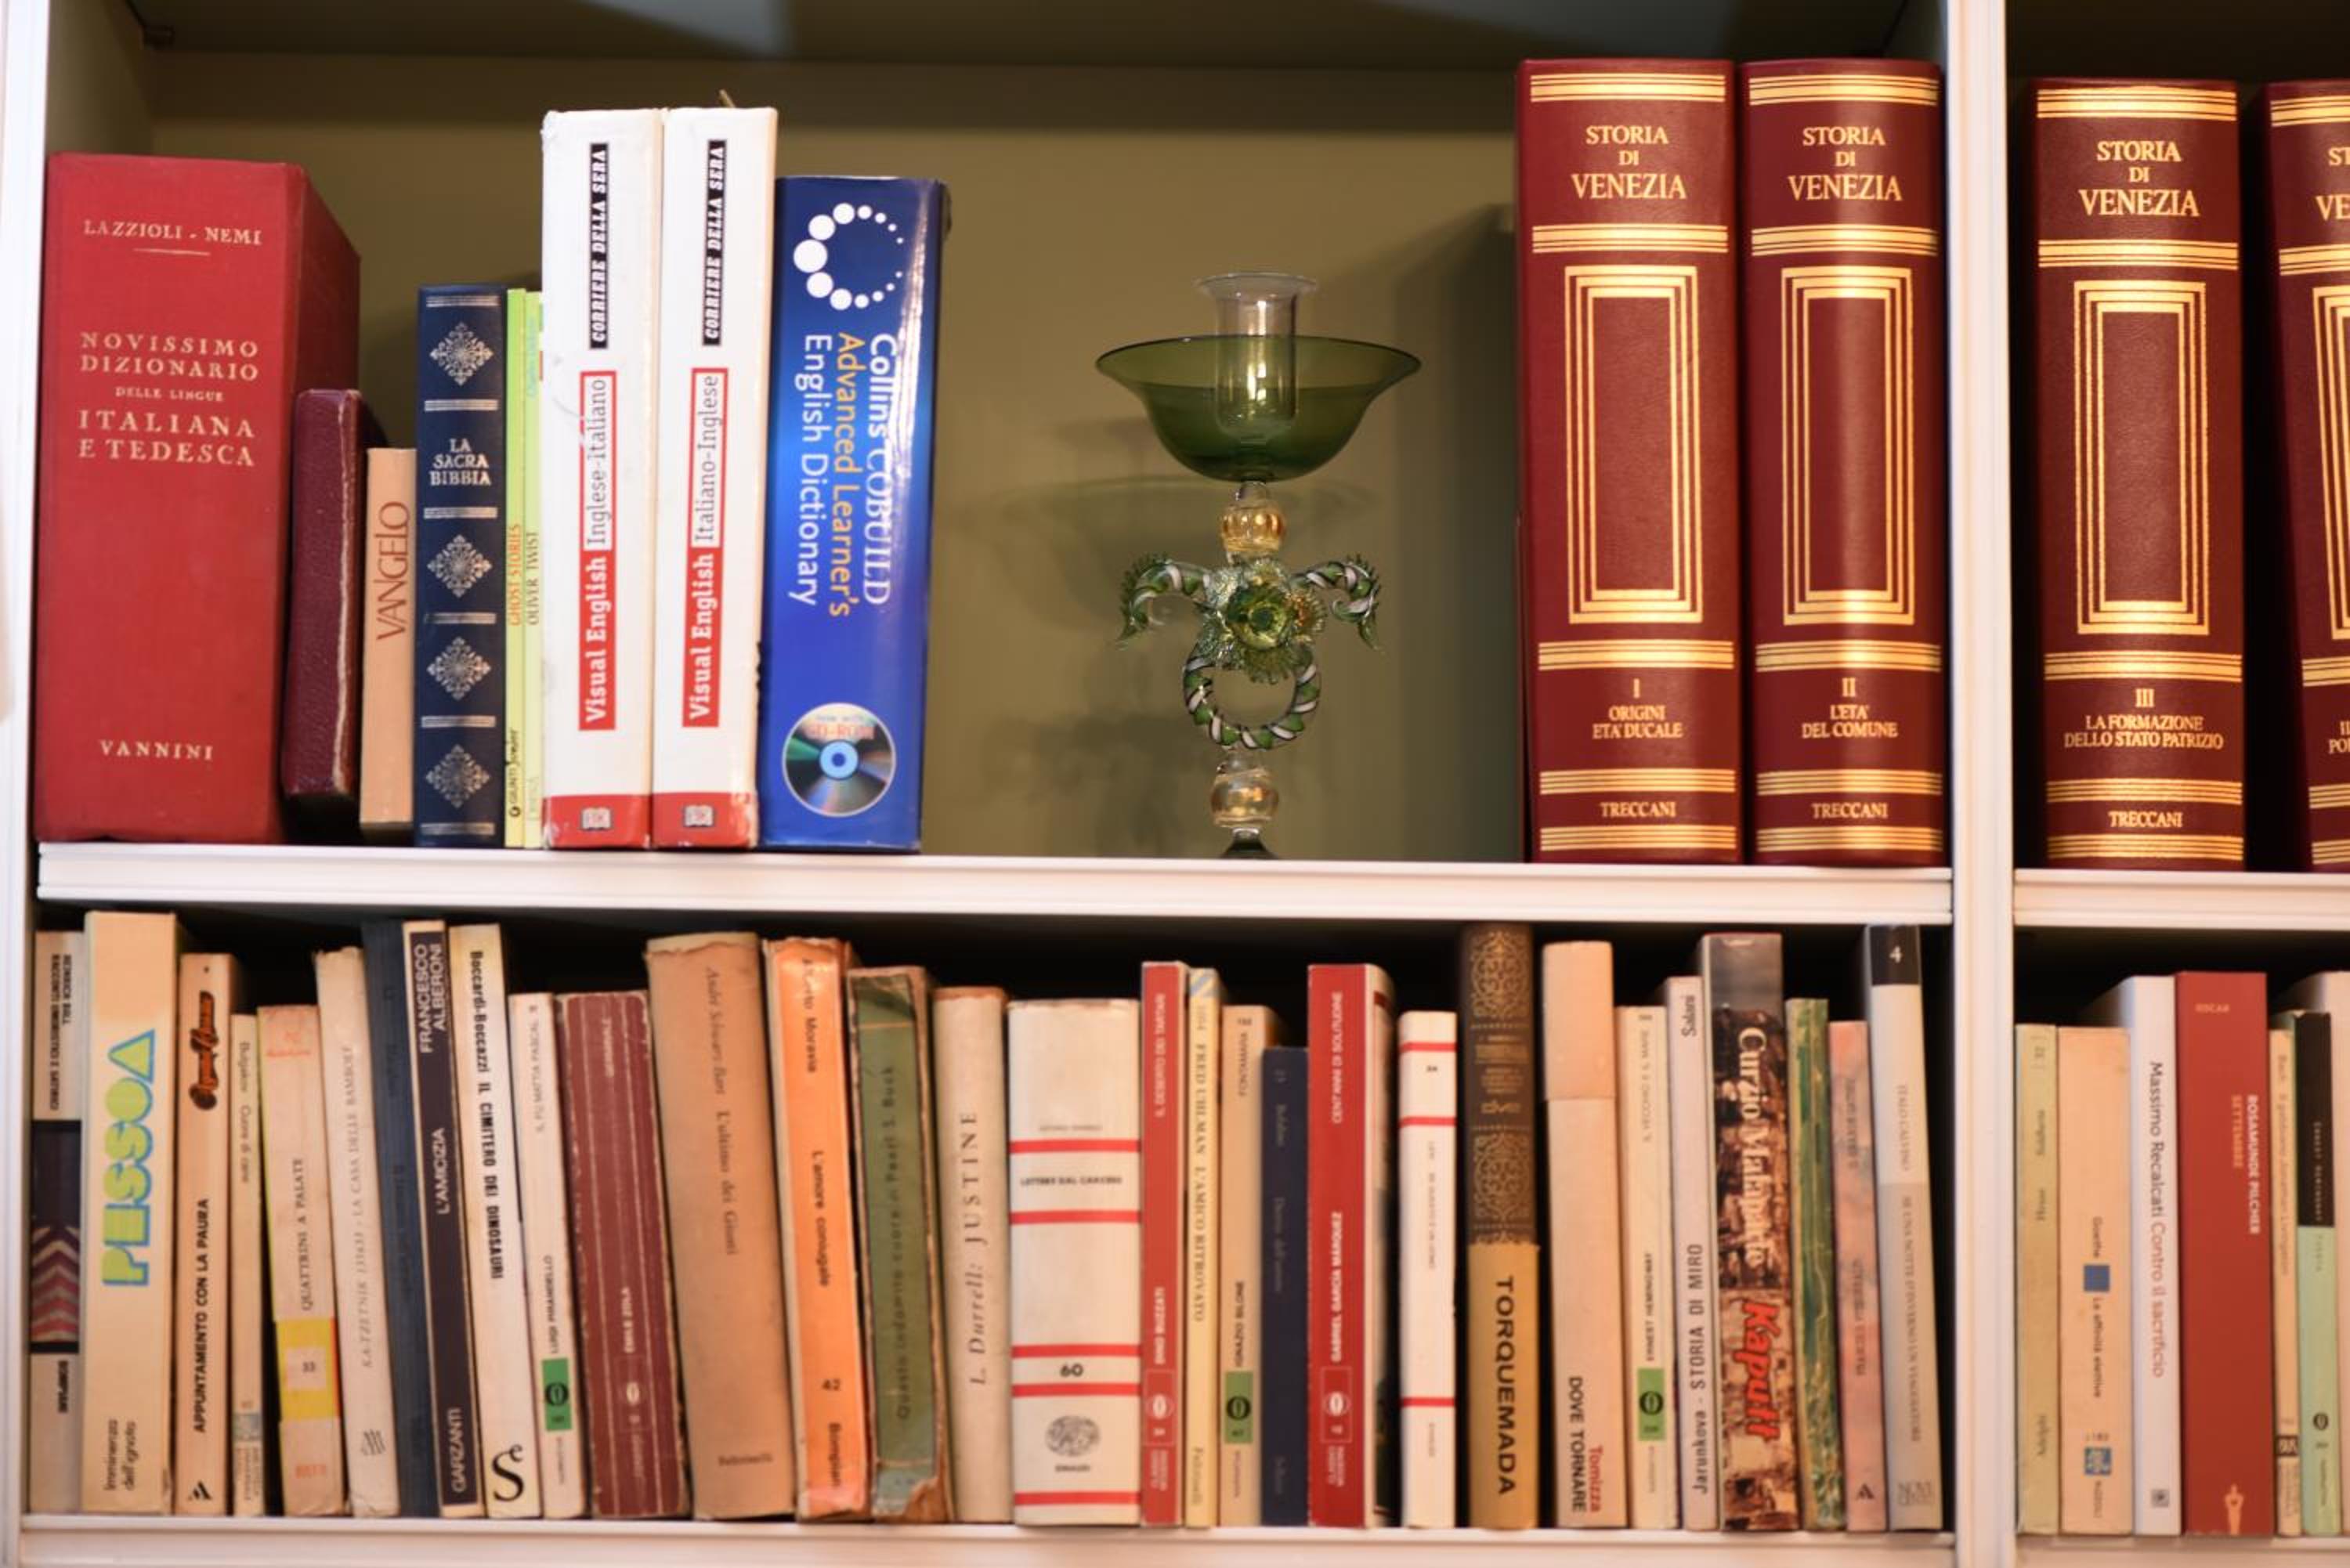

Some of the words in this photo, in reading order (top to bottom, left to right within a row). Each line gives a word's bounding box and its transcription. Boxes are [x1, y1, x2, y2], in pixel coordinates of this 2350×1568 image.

[1585, 125, 1669, 146] STORIA
[1618, 150, 1640, 166] DI
[1802, 126, 1886, 146] STORIA
[1835, 151, 1856, 168] DI
[2097, 140, 2182, 162] STORIA
[590, 150, 606, 193] SERA
[708, 147, 725, 190] SERA
[1571, 173, 1687, 201] VENEZIA
[1788, 175, 1903, 201] VENEZIA
[2129, 166, 2150, 182] DI
[707, 198, 724, 250] DELLA
[2079, 189, 2200, 217] VENEZIA
[84, 219, 183, 240] LAZZIOLI
[204, 226, 262, 245] NEMI
[590, 201, 606, 254] DELLA
[590, 261, 606, 343] CORRIERE
[704, 256, 723, 339] CORRIERE
[81, 332, 258, 359] NOVISSIMO
[81, 355, 258, 381] DIZIONARIO
[115, 386, 162, 399] DELLE
[170, 388, 223, 402] LINGUE
[794, 334, 832, 443] English
[834, 332, 866, 472] Advanced
[868, 334, 898, 439] Collins
[79, 410, 255, 438] ITALIANA
[449, 438, 472, 453] LA
[79, 439, 96, 459] E
[105, 439, 255, 467] TEDESCA
[432, 453, 490, 469] SACRA
[586, 379, 613, 545] Inglese-Italiano
[693, 375, 722, 541] Italiano-Inglese
[429, 470, 493, 486] BIBBIA
[508, 523, 522, 577] STORIES
[788, 453, 828, 605] Dictionary
[829, 484, 860, 616] Learner's
[864, 447, 893, 605] COBUILD
[374, 501, 409, 641] VANGELO
[524, 531, 539, 571] TWIST
[508, 582, 522, 627] GHOST
[525, 578, 540, 626] OLIVER
[588, 557, 613, 642] English
[692, 554, 718, 639] English
[586, 651, 609, 722] Visual
[689, 647, 713, 719] Visual
[1633, 678, 1640, 699] I
[1842, 677, 1857, 698] II
[2135, 688, 2154, 708] III
[1608, 705, 1666, 722] ORIGINI
[1624, 722, 1683, 739] DUCALE
[1802, 722, 1831, 739] DEL
[1832, 721, 1899, 739] COMUNE
[2086, 715, 2106, 731] LA
[2107, 714, 2204, 732] FORMAZIONE
[99, 739, 214, 761] VANNINI
[2064, 732, 2113, 748] DELLO
[2115, 732, 2160, 747] STATO
[2162, 732, 2225, 750] PATRIZIO
[1600, 800, 1677, 818] TRECCANI
[1812, 802, 1889, 820] TRECCANI
[2109, 811, 2184, 828] TRECCANI
[1889, 945, 1902, 963] 4
[414, 944, 433, 1053] FRANCESCO
[430, 944, 446, 1031] ALBERONI
[470, 950, 490, 1073] Boccardi-Boccazzi
[1680, 995, 1697, 1037] Salani
[804, 1017, 819, 1073] Moravia
[1195, 1042, 1207, 1086] FRED
[478, 1082, 491, 1094] IL
[1737, 1026, 1768, 1120] Curzio
[1195, 1088, 1207, 1154] UHLMAN
[2149, 1061, 2164, 1136] Massimo
[479, 1102, 497, 1167] CIMITERO
[2247, 1094, 2259, 1179] ROSAMUNDE
[292, 1158, 306, 1209] PALATE
[349, 1158, 362, 1194] CASA
[432, 1128, 451, 1214] L'AMICIZIA
[483, 1174, 497, 1197] DEI
[959, 1112, 988, 1246] JUSTINE
[2150, 1141, 2165, 1217] Recalcati
[1194, 1166, 1206, 1231] L'AMICO
[1735, 1122, 1773, 1269] Malaparte
[2248, 1180, 2261, 1234] PILCHER
[195, 1198, 210, 1248] PAURA
[296, 1215, 307, 1225] A
[485, 1205, 504, 1280] DINOSAURI
[195, 1254, 209, 1272] LA
[297, 1231, 314, 1312] QUATTRINI
[1686, 1244, 1703, 1290] MIRO
[2151, 1221, 2167, 1279] Contro
[194, 1277, 208, 1306] CON
[1193, 1234, 1206, 1322] RITROVATO
[2153, 1287, 2167, 1295] il
[1687, 1299, 1705, 1316] DI
[1331, 1313, 1343, 1363] GABRIEL
[1688, 1327, 1705, 1389] STORIA
[2152, 1301, 2167, 1378] sacrificio
[193, 1311, 208, 1433] APPUNTAMENTO
[822, 1378, 841, 1391] 42
[1059, 1363, 1085, 1378] 60
[1495, 1275, 1517, 1495] TORQUEMADA
[1732, 1302, 1781, 1441] Kaputt
[1568, 1376, 1585, 1424] DOVE
[446, 1407, 468, 1493] GARZANTI
[1570, 1429, 1588, 1512] TORNARE
[1692, 1411, 1708, 1494] Jarunkova
[1588, 1444, 1604, 1512] Tomizza
